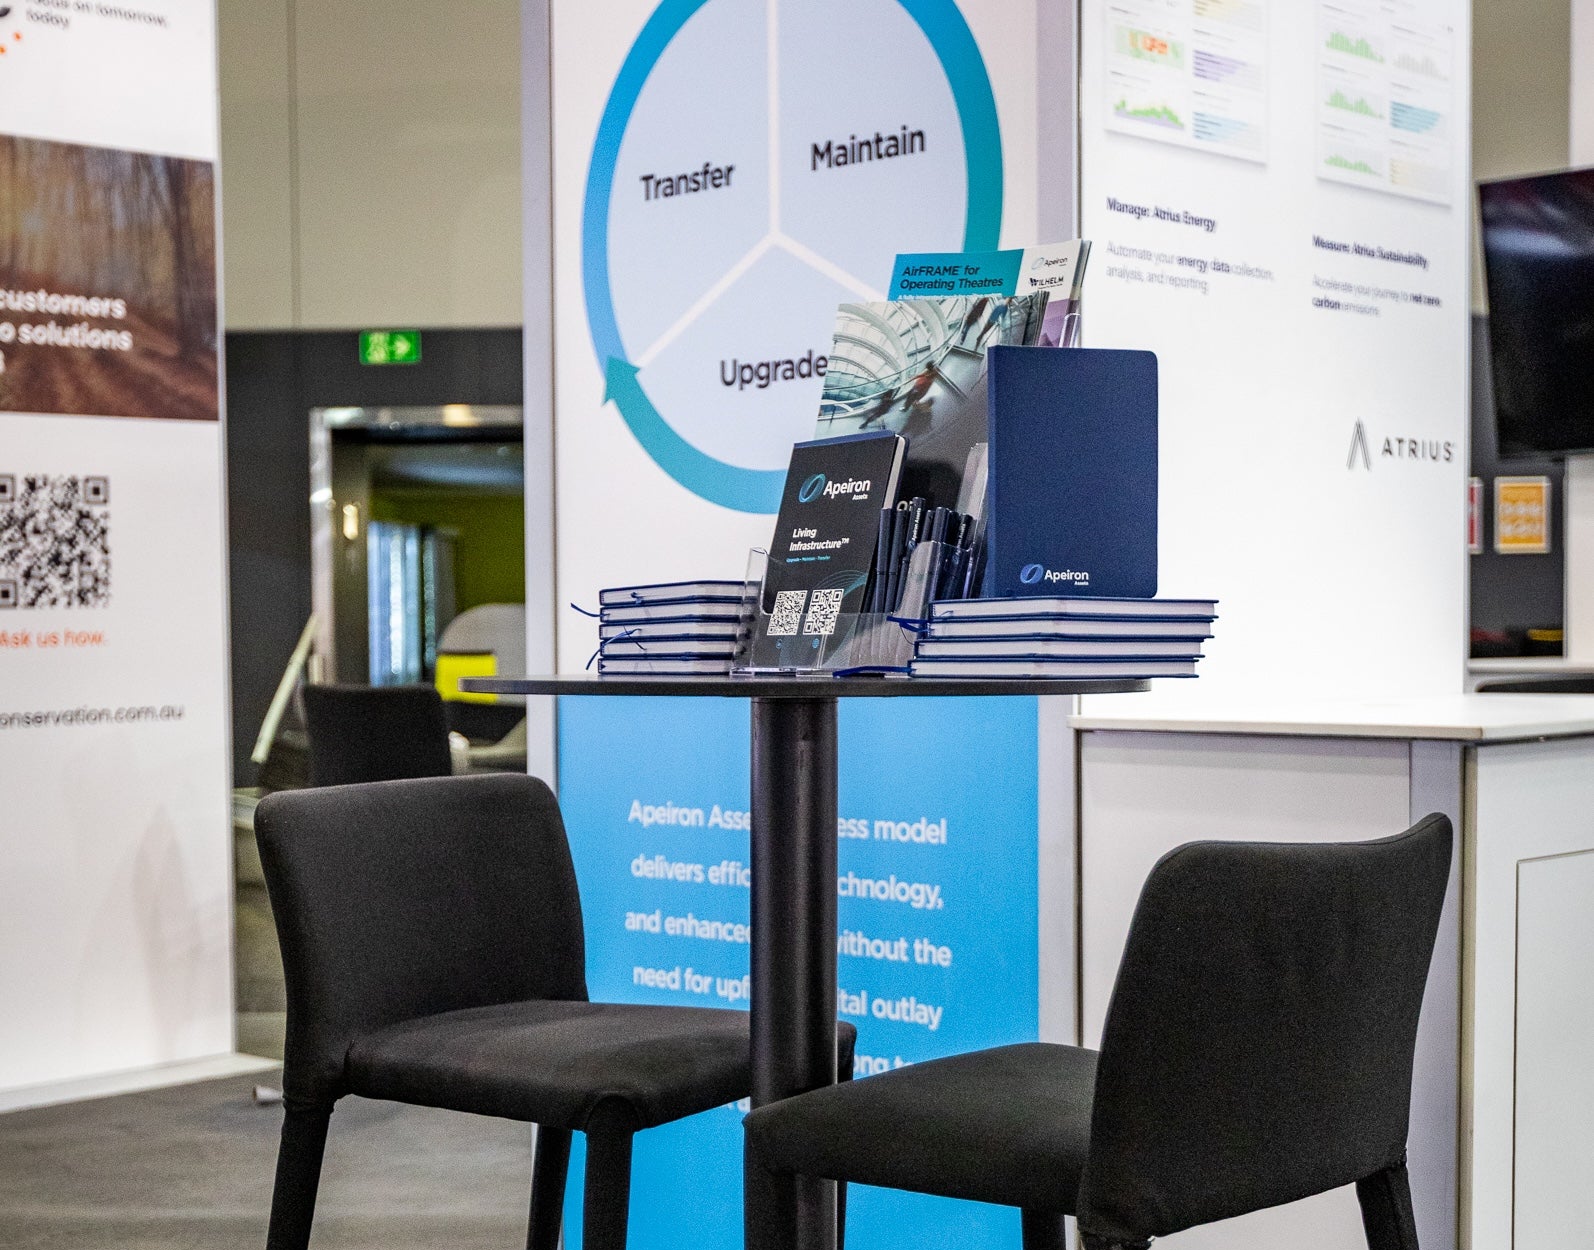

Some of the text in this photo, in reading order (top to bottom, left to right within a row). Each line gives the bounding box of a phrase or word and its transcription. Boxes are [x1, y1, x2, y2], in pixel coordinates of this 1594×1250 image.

[811, 124, 927, 171] Maintain
[640, 162, 735, 201] Transfer
[1106, 197, 1216, 233] Manage: Atrius Energy
[1044, 257, 1068, 267] Apeiron
[1106, 240, 1152, 262] Automate
[1154, 251, 1175, 265] your
[1177, 254, 1208, 273] energy
[1210, 257, 1230, 274] data
[1312, 234, 1429, 272] Measure: Atrius Sustainability
[900, 277, 1004, 290] Operating Theatres
[964, 264, 980, 275] for
[1147, 270, 1163, 284] and
[1312, 295, 1340, 311] carbon
[18, 320, 133, 351] solutions
[720, 349, 829, 391] Upgrade
[1382, 436, 1453, 463] ATRIUS
[823, 477, 871, 499] Apeiron
[792, 527, 817, 538] Living
[1044, 569, 1089, 583] Apeiron
[0, 629, 30, 648] Ask
[36, 630, 59, 648] us
[0, 704, 185, 730] onservation.com.au
[628, 799, 704, 827] Apeiron
[708, 804, 750, 830] Asse
[874, 816, 948, 845] model
[631, 853, 944, 910] delivers effic chnology,
[625, 909, 662, 934] and
[913, 937, 952, 967] the
[633, 965, 681, 991] need
[684, 967, 712, 994] for
[871, 996, 943, 1031] outlay
